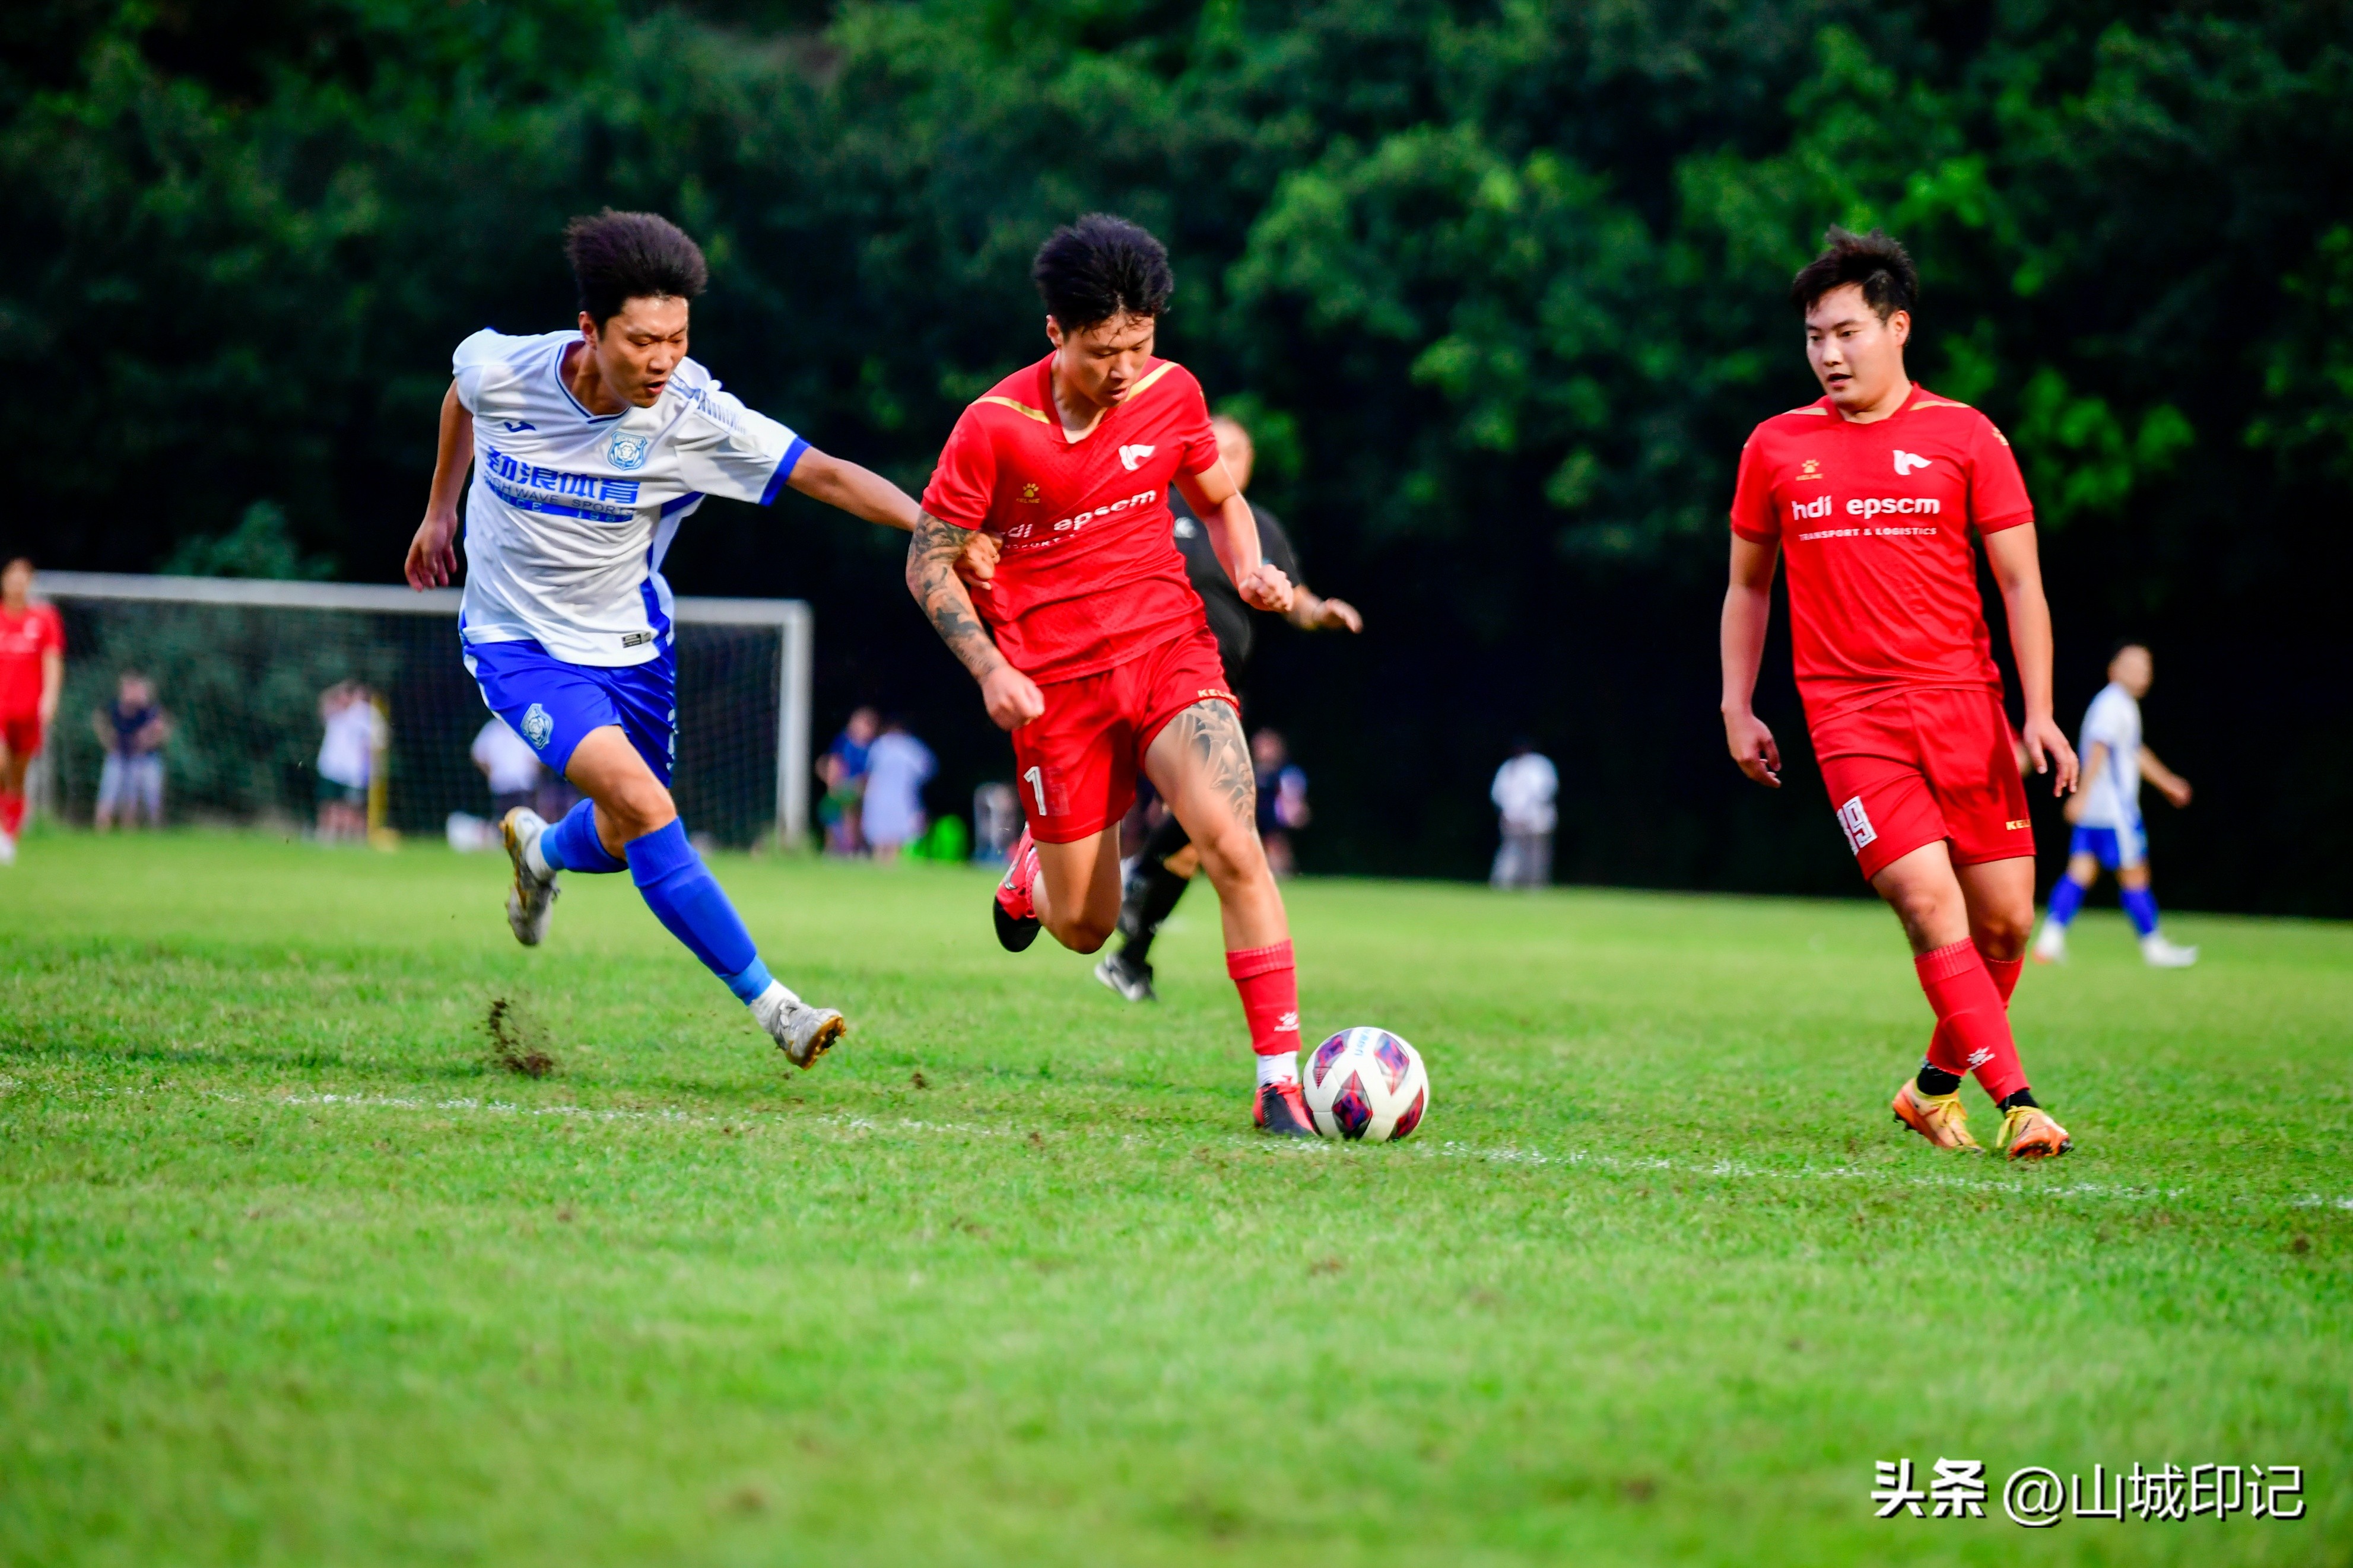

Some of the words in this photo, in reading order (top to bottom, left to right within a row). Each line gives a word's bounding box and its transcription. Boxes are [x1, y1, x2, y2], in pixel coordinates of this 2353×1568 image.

[516, 487, 559, 504] WAVE
[1054, 489, 1157, 531] epscm
[1791, 495, 1832, 520] hdi
[1846, 497, 1941, 519] epscm
[1798, 528, 1860, 541] TRANSPORT
[1863, 528, 1872, 536] &
[1875, 527, 1937, 536] LOGISTICS
